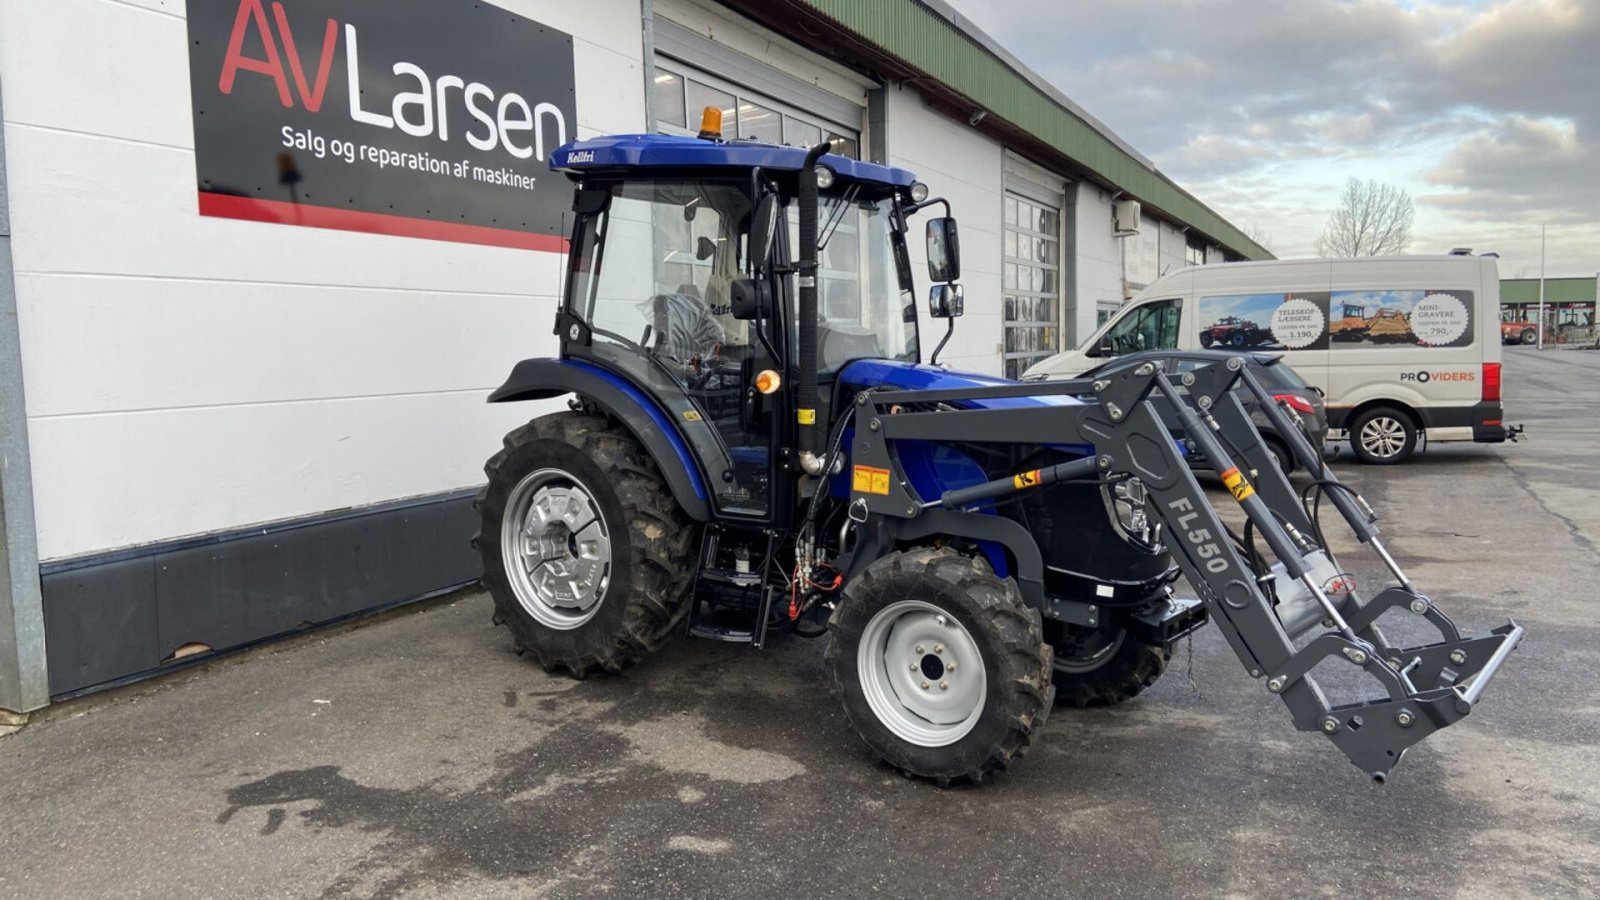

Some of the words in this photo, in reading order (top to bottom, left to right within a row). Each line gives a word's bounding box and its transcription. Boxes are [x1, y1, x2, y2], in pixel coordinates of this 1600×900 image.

[344, 23, 565, 161] Larsen
[281, 126, 325, 158] Salg
[331, 140, 355, 163] og
[360, 144, 450, 176] reparation
[453, 160, 469, 178] af
[473, 165, 536, 190] maskiner
[567, 150, 595, 163] Kellfri
[1400, 371, 1475, 383] PROVIDERS
[1168, 497, 1229, 573] FL550
